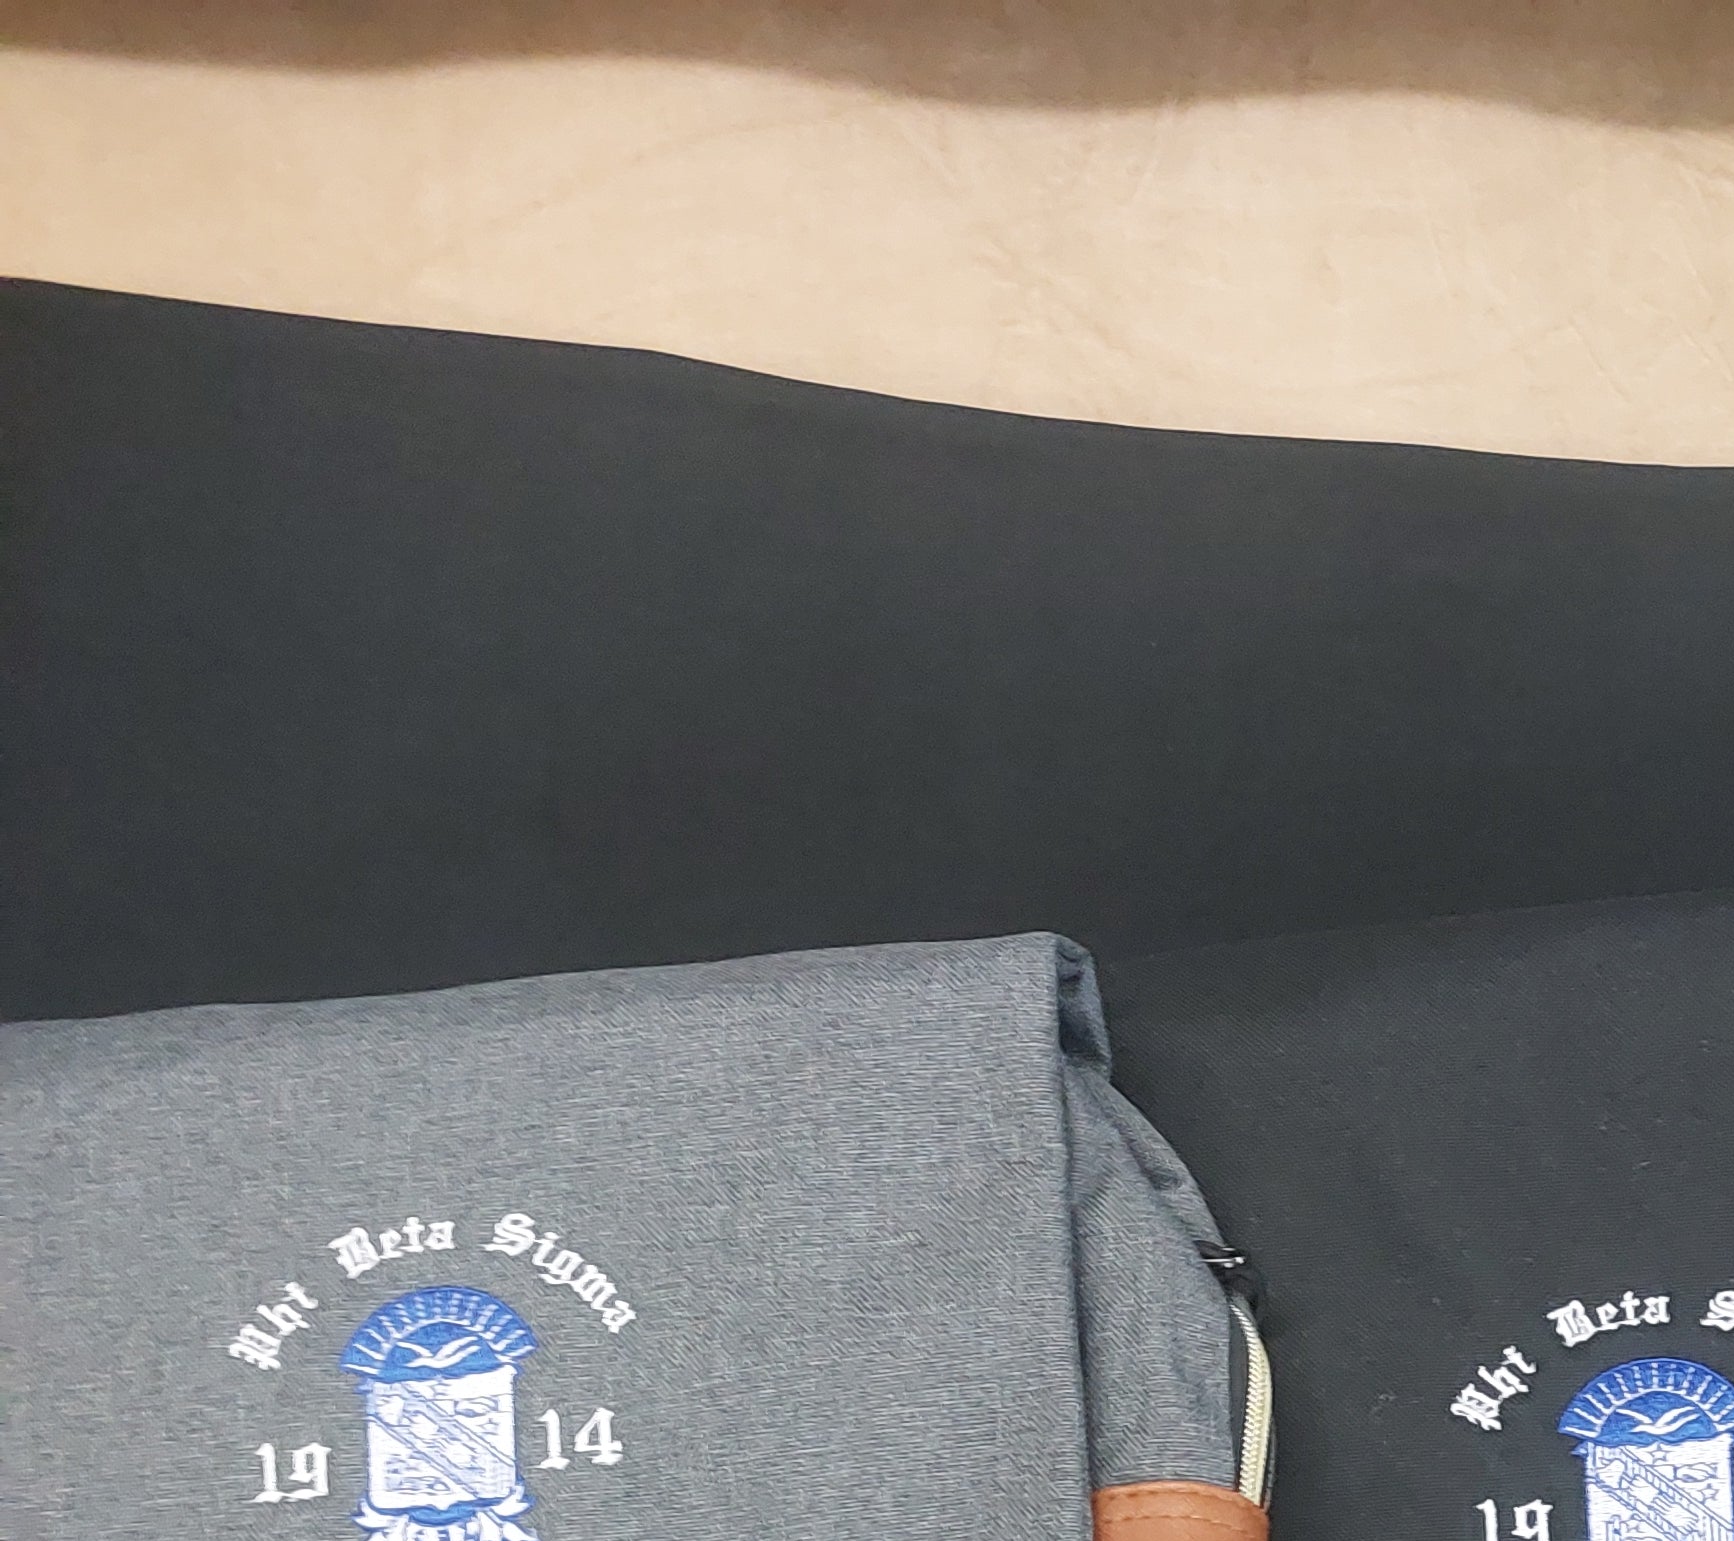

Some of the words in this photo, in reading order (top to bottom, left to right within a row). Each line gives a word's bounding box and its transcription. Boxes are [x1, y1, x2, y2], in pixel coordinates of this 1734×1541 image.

[229, 1281, 319, 1370] Phi
[327, 1216, 456, 1279] Beta
[480, 1211, 636, 1333] Sigma
[1450, 1345, 1536, 1431] Phi
[1546, 1291, 1670, 1347] Beta
[251, 1442, 331, 1503] 19
[532, 1407, 623, 1470] 14
